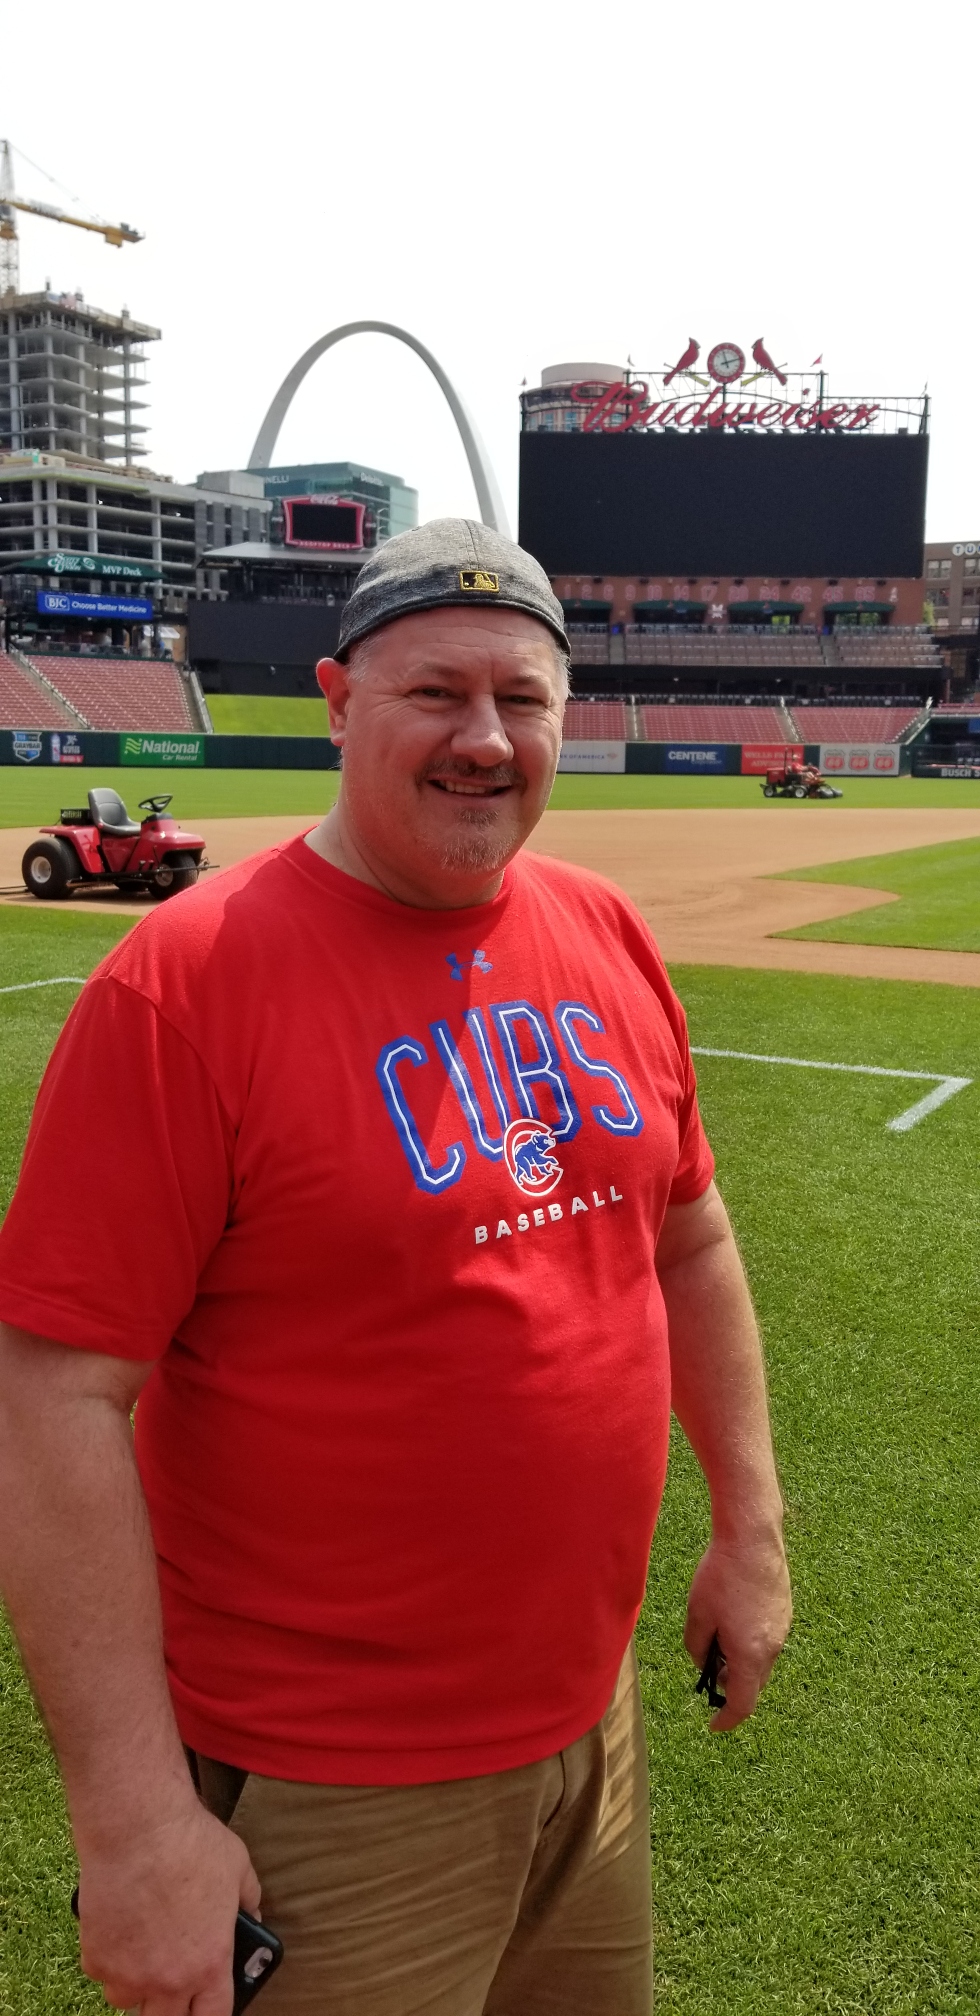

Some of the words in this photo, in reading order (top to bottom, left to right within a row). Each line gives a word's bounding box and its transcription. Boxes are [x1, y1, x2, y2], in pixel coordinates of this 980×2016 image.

[570, 381, 881, 433] Budweiser
[102, 565, 122, 575] MVP
[48, 597, 67, 608] BJC
[142, 740, 200, 754] National
[668, 751, 717, 761] CENTENE
[941, 768, 972, 777] BUSCH
[375, 999, 645, 1196] CUBS
[474, 1185, 623, 1245] BASEBALL
